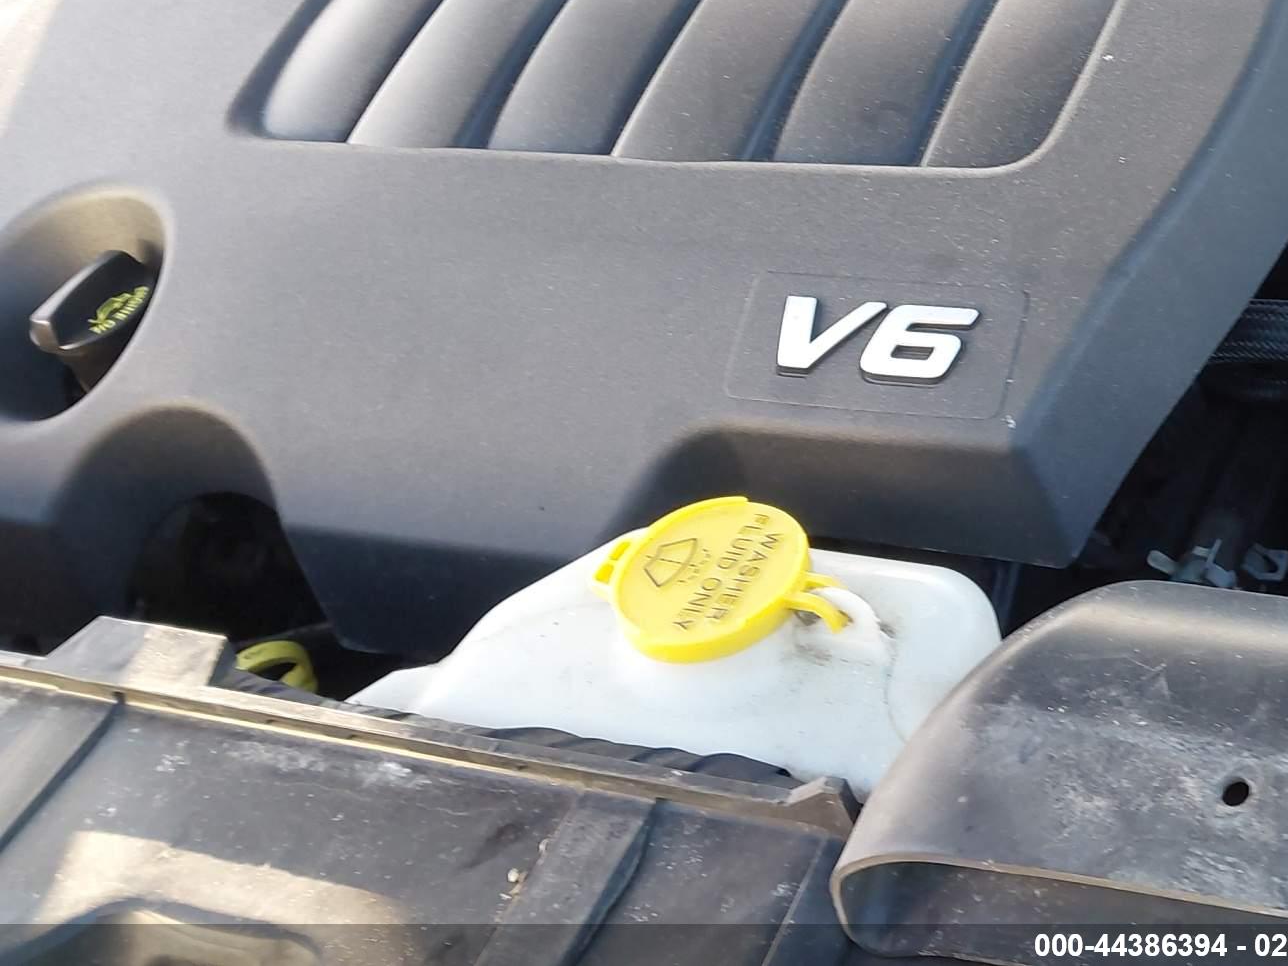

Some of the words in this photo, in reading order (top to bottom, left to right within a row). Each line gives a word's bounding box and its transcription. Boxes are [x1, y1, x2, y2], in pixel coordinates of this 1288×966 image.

[776, 295, 981, 383] V6
[705, 533, 784, 620] WASHER
[717, 513, 770, 570] FLUID
[672, 577, 722, 630] ONLY
